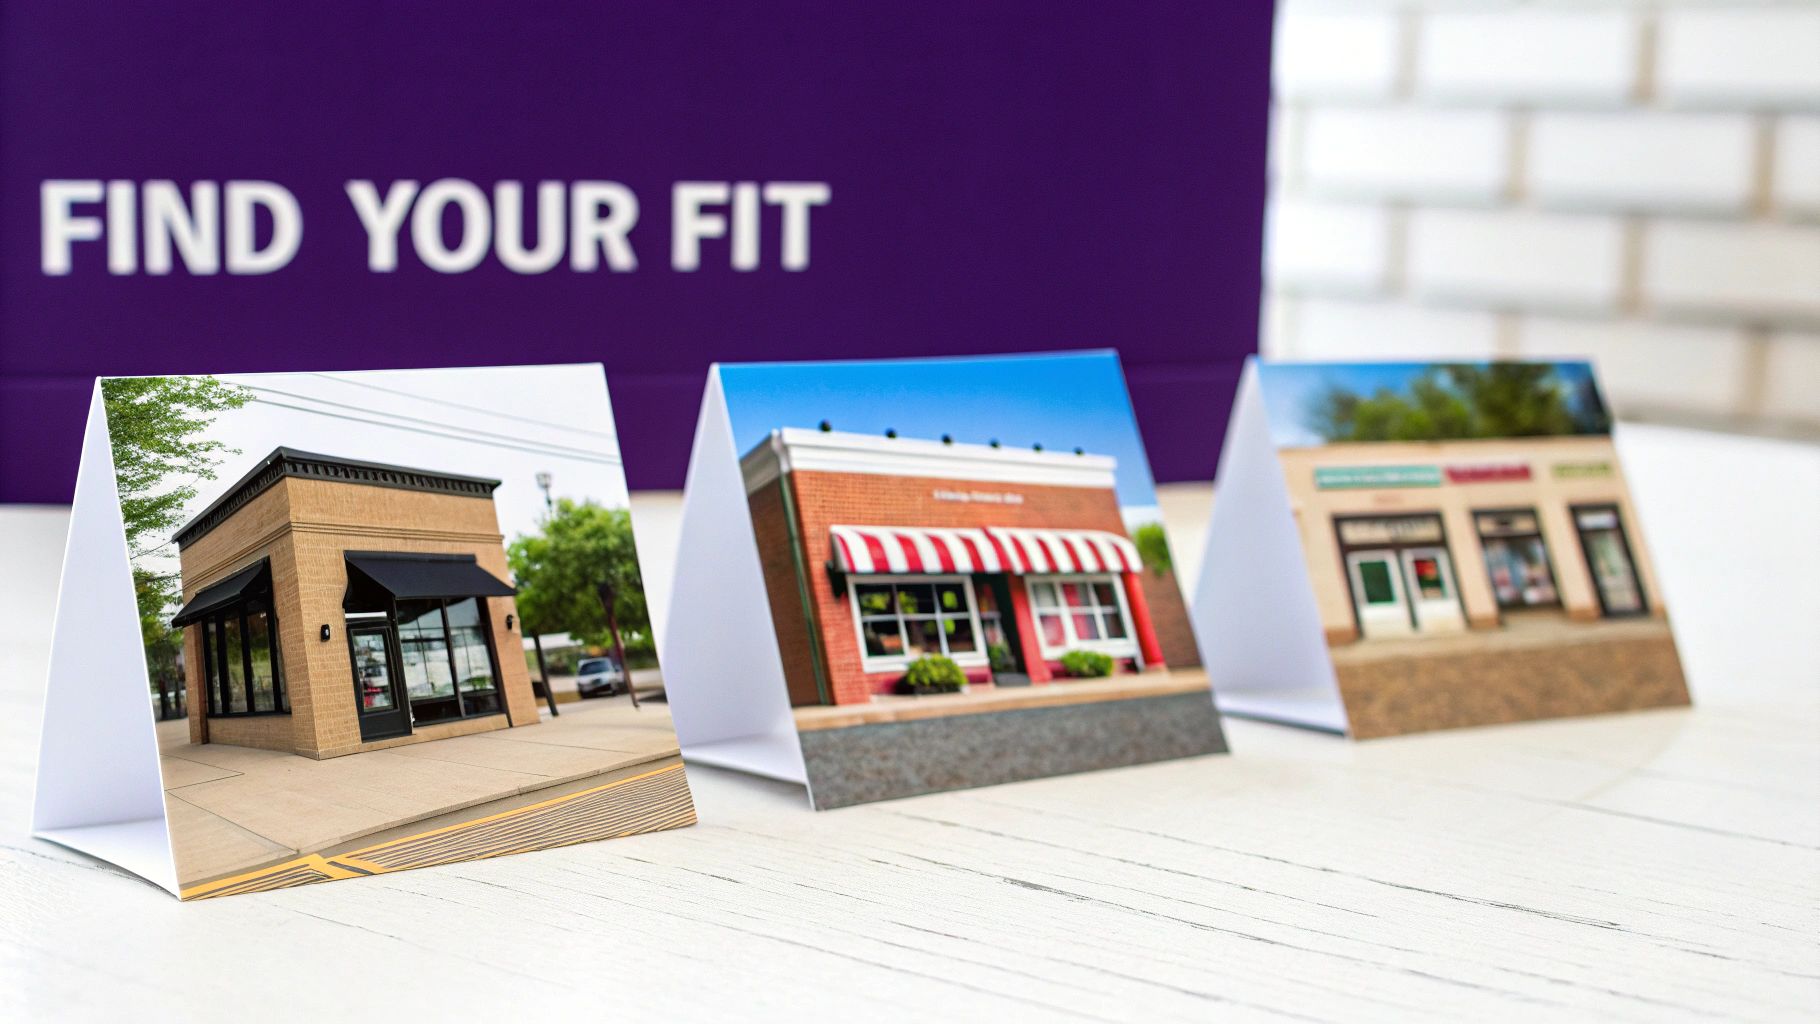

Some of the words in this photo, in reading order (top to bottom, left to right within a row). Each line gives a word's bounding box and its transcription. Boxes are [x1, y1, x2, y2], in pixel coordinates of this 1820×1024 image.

[40, 180, 303, 276] FIND
[346, 179, 639, 274] YOUR
[671, 181, 831, 273] FIT
